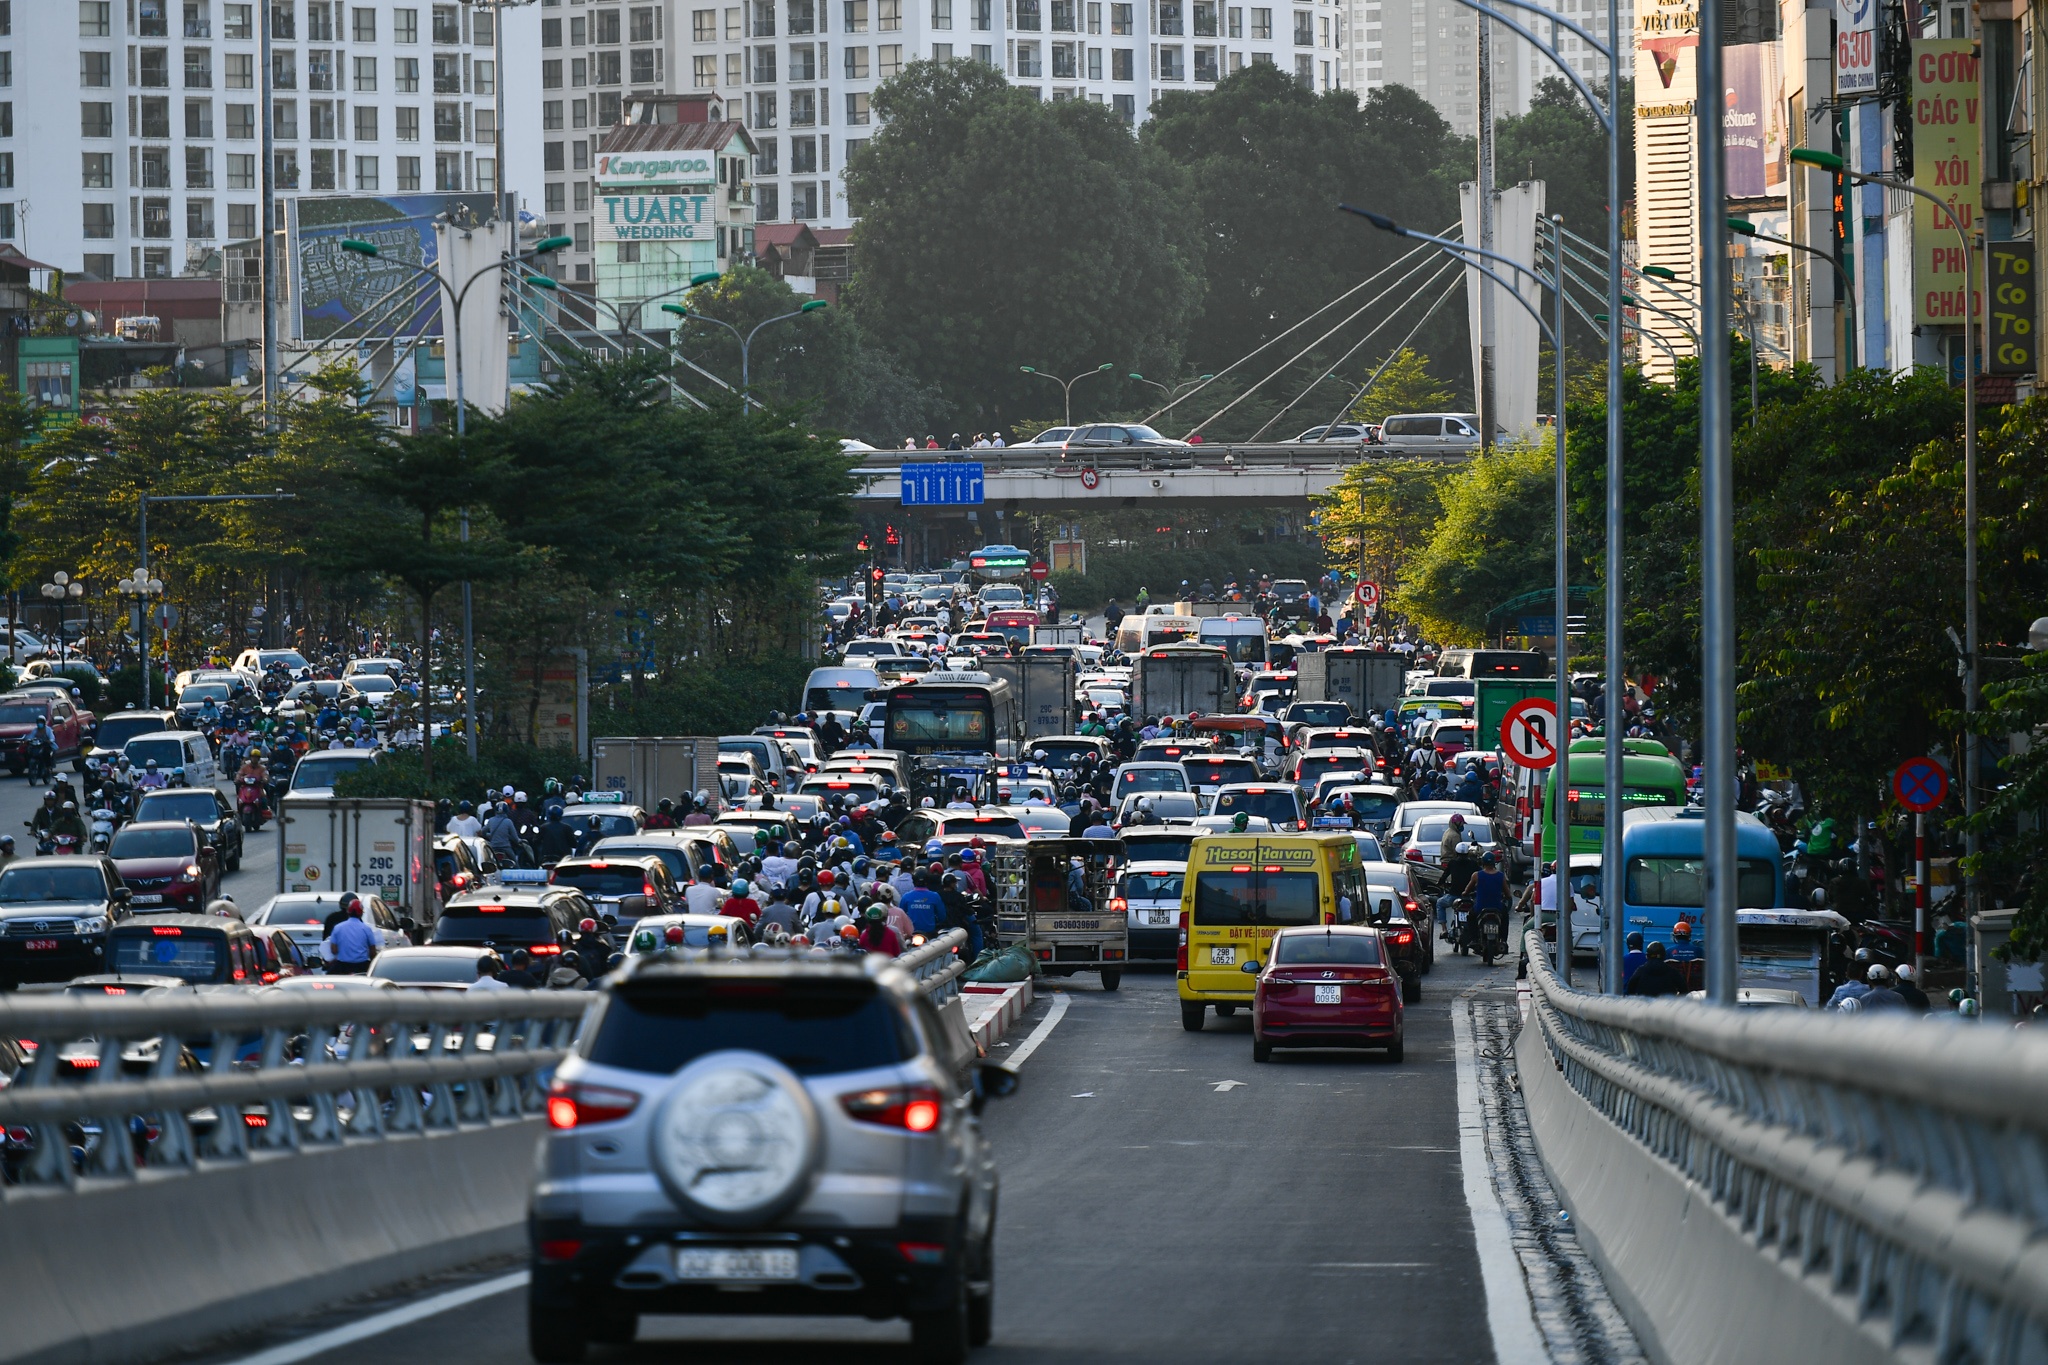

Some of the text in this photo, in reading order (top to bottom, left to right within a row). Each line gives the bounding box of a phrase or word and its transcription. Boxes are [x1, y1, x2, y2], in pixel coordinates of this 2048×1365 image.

[1642, 4, 1699, 35] VIỆT TIẾN
[1838, 31, 1872, 69] 630
[1919, 51, 1979, 83] CƠM
[1858, 73, 1874, 88] CHINH
[1917, 94, 1959, 125] CÁC
[1934, 155, 1970, 186] XÔI
[603, 196, 708, 224] TUART
[1933, 193, 1972, 230] LẨU
[615, 225, 694, 239] WEDDING
[1926, 282, 1982, 318] CHÁO
[1040, 705, 1052, 713] 29C
[1011, 766, 1024, 777] G7
[606, 776, 626, 788] 36C
[1208, 848, 1257, 863] Hason
[369, 857, 393, 869] 29C
[360, 874, 402, 887] 259.26
[1053, 920, 1100, 929] 0836039690
[1229, 929, 1243, 940] ĐẶT
[1246, 927, 1256, 938] VÉ:
[1321, 986, 1335, 994] 30G
[1315, 995, 1340, 1003] 009.59
